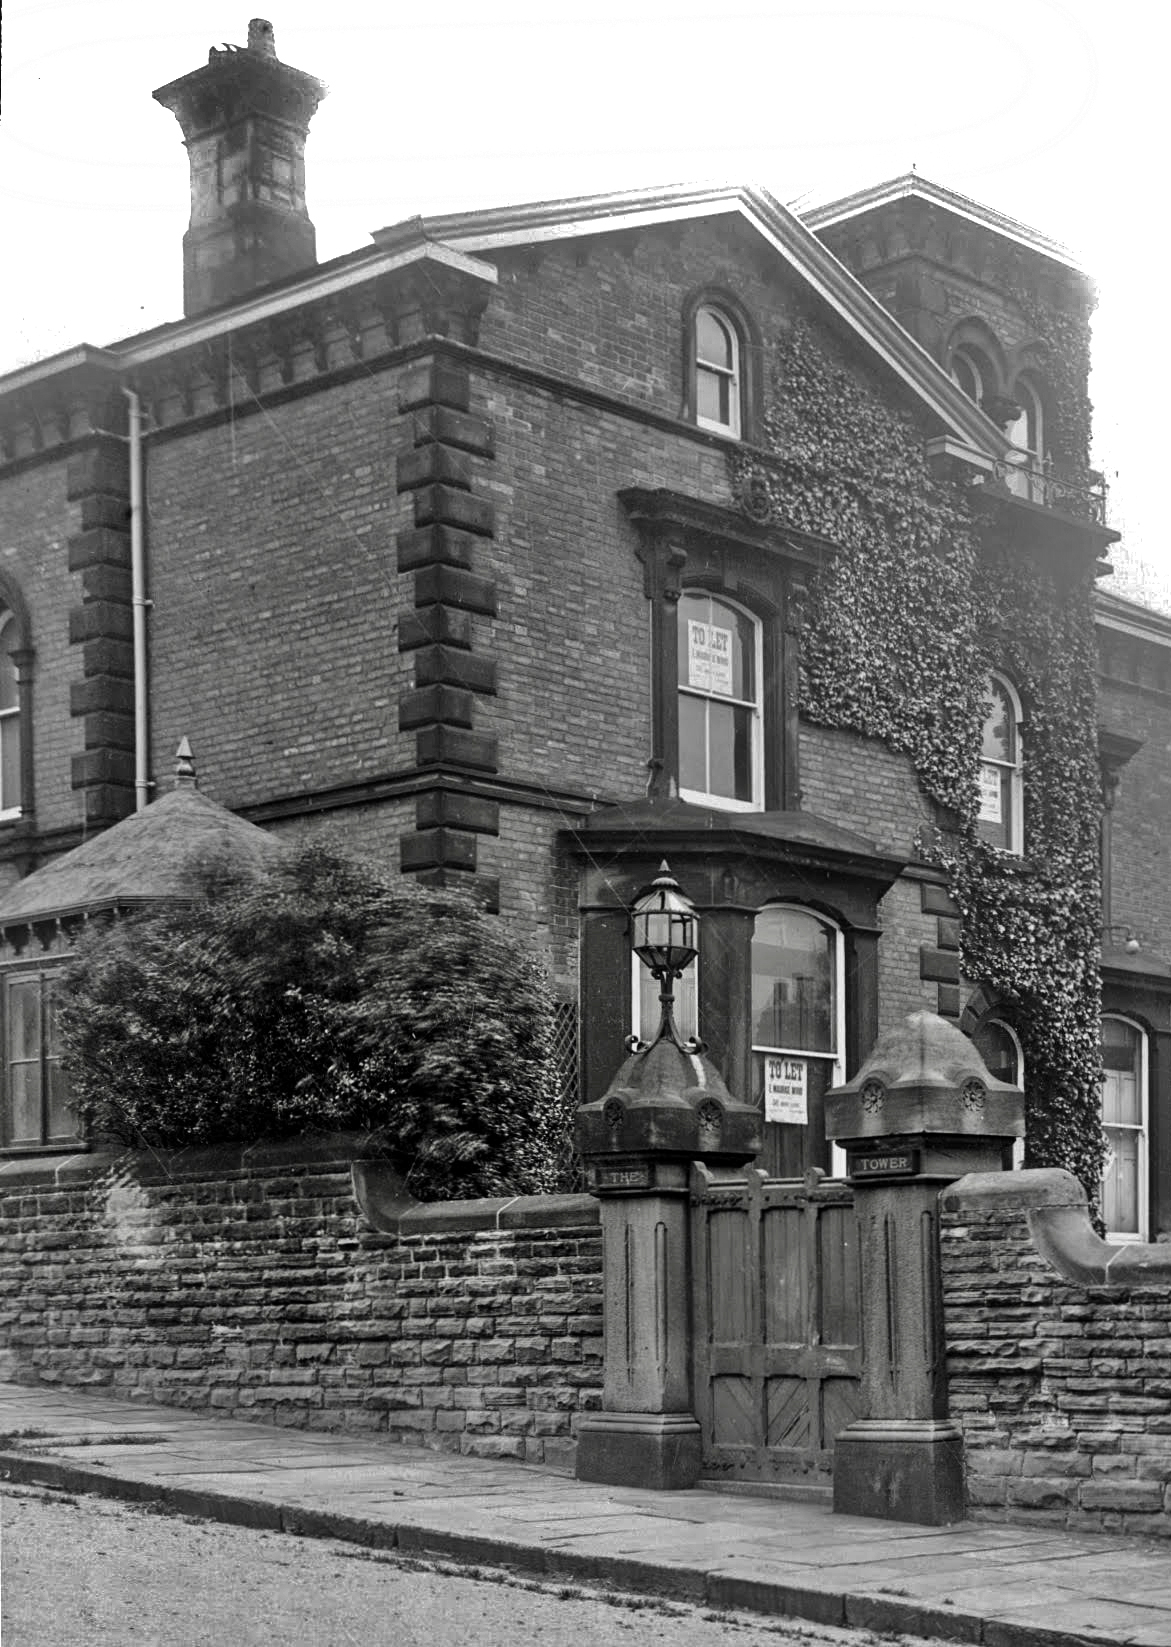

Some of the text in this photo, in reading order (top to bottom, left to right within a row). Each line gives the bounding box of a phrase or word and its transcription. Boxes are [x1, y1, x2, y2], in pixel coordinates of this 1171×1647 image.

[692, 625, 728, 651] TO LET
[769, 1060, 803, 1081] TO LET
[860, 1157, 908, 1170] TOWER
[609, 1171, 641, 1185] THE
